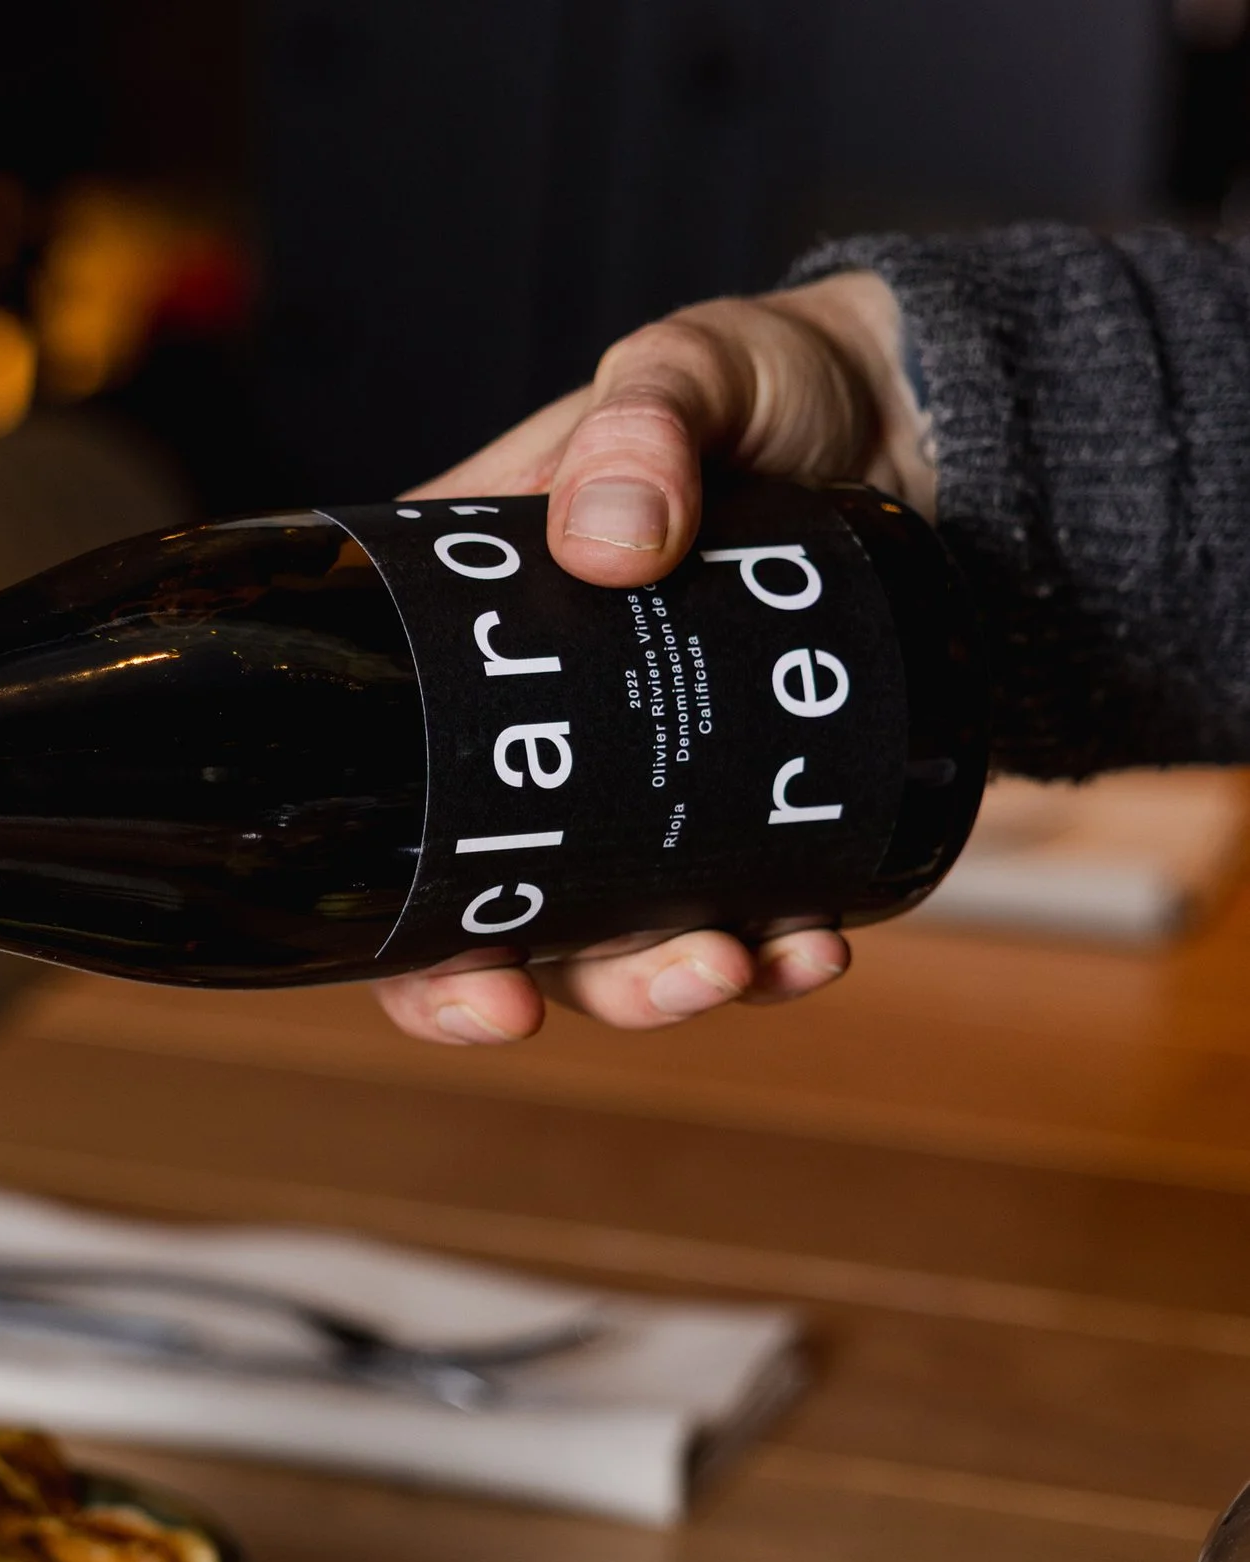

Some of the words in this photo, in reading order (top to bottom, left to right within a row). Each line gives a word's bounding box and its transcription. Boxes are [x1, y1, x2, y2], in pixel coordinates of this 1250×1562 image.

[627, 595, 651, 644] Vinos
[651, 597, 667, 617] de
[624, 669, 642, 709] 2022
[644, 650, 665, 717] Riviere
[661, 623, 690, 762] Denominacion
[687, 635, 713, 735] Calificada
[701, 544, 850, 825] red
[651, 723, 667, 788] Olivier
[662, 803, 686, 848] Rioja
